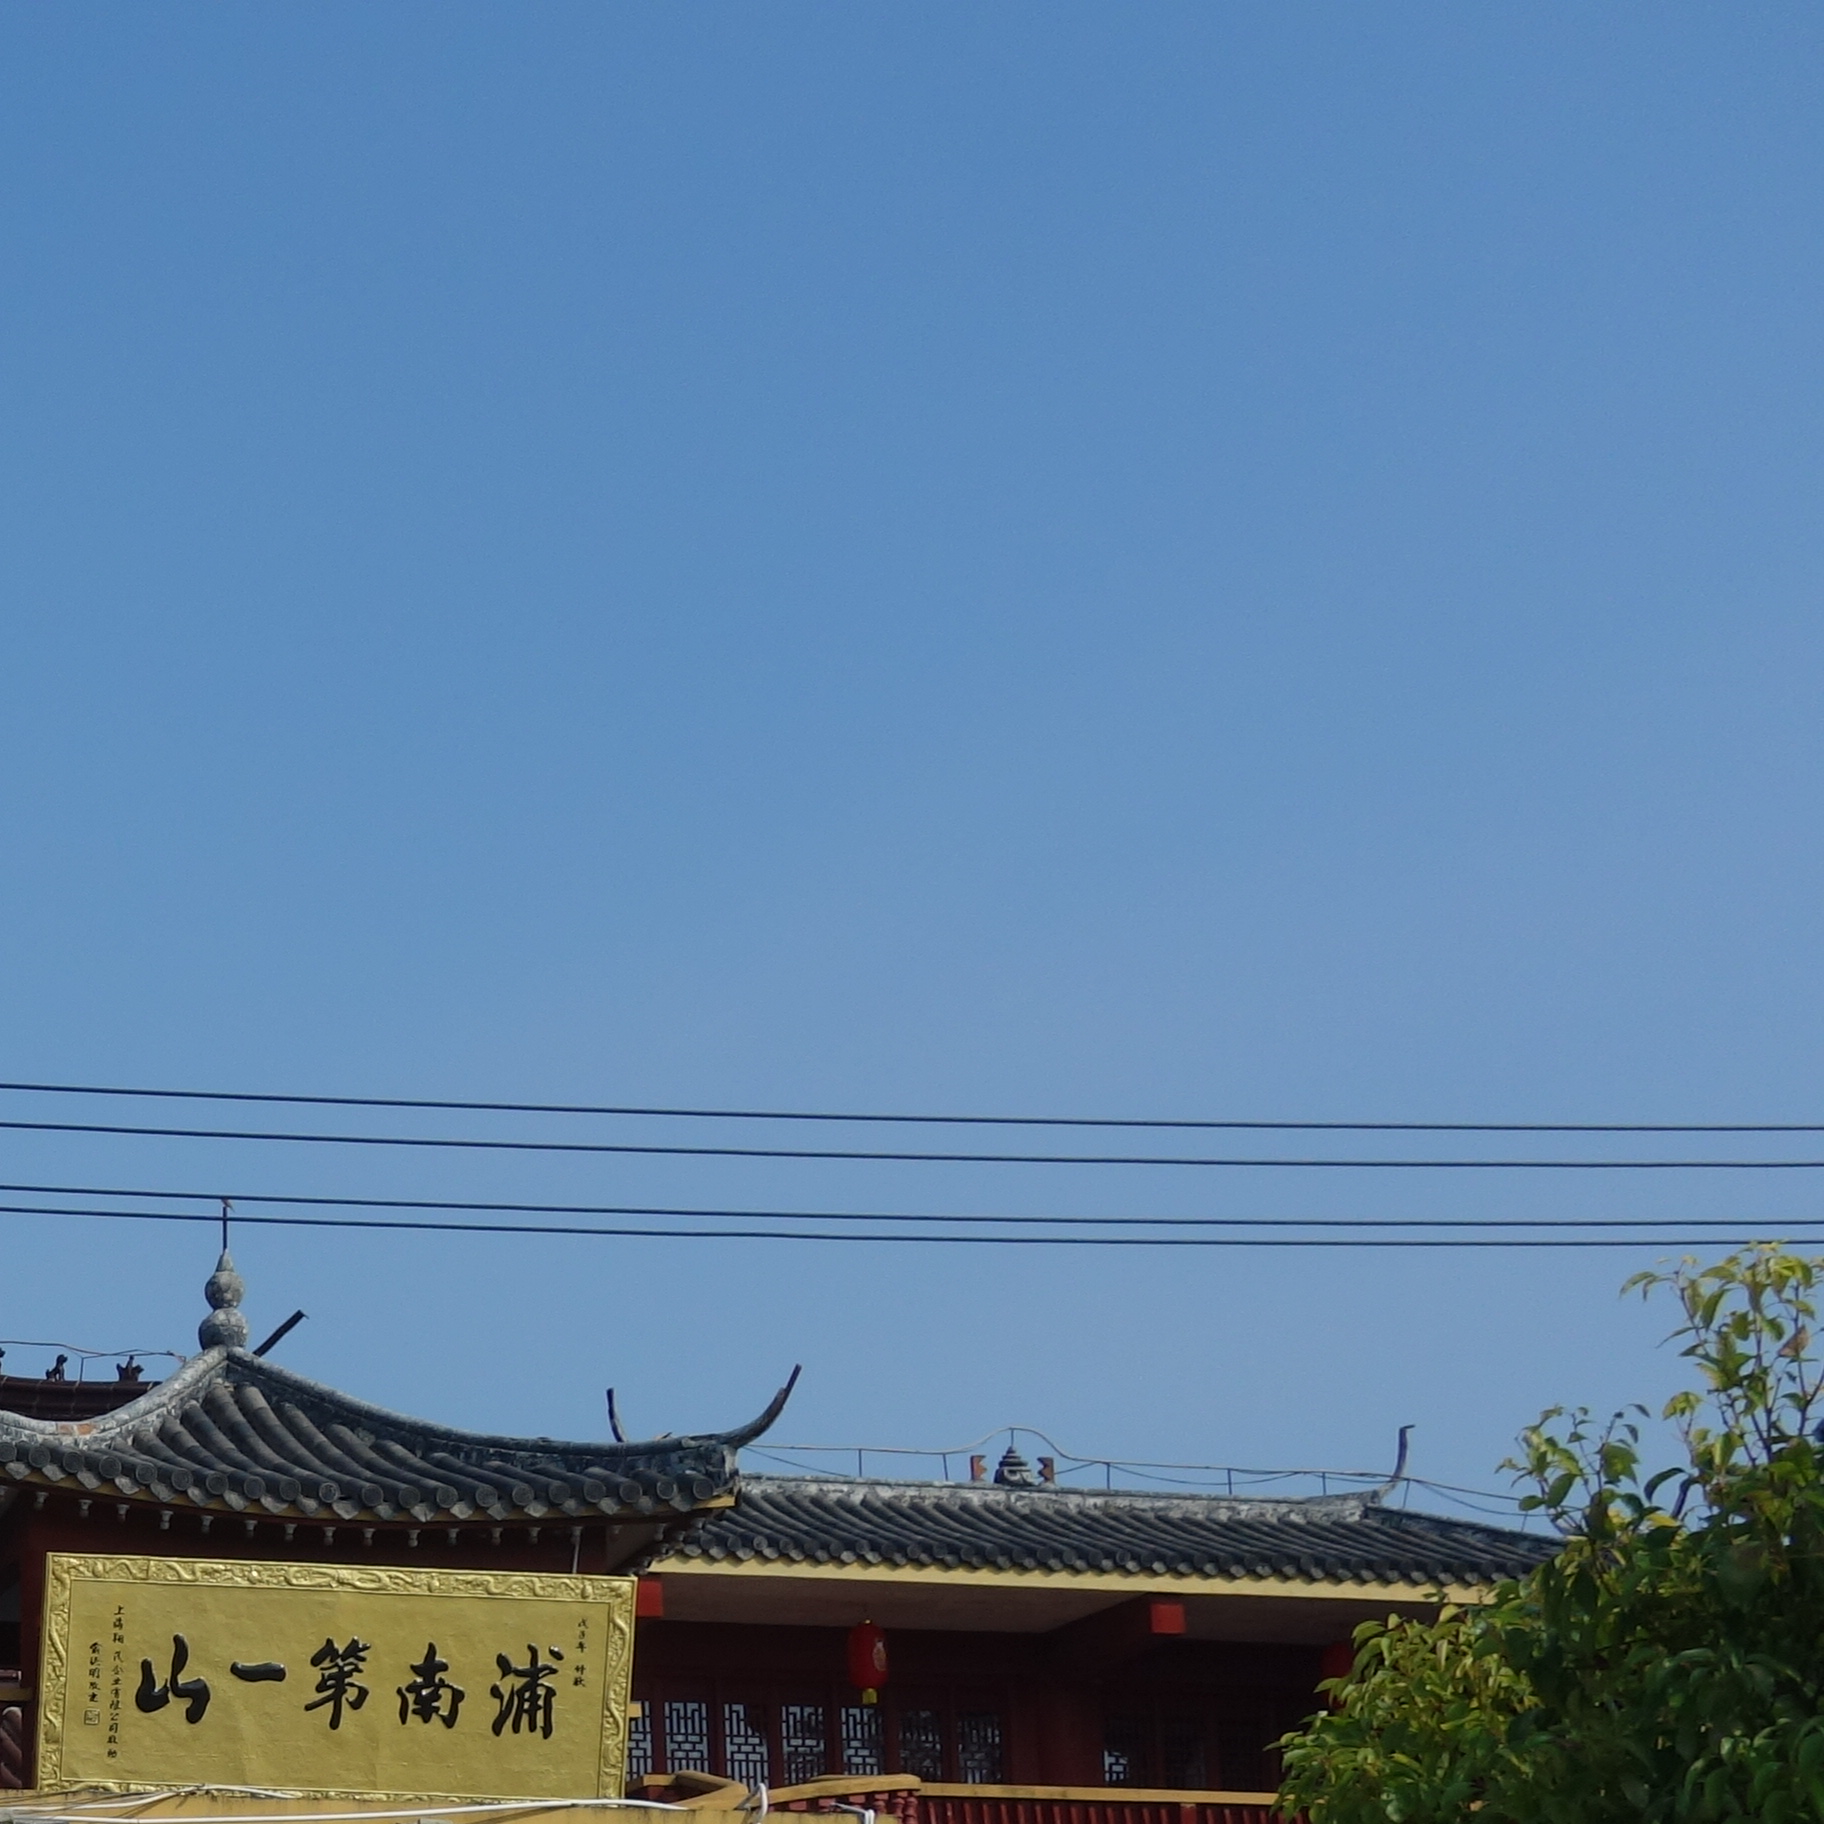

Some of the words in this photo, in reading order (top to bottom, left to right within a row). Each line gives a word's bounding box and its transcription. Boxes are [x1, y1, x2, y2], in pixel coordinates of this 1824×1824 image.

[134, 1634, 564, 1740] 浦南第一山
